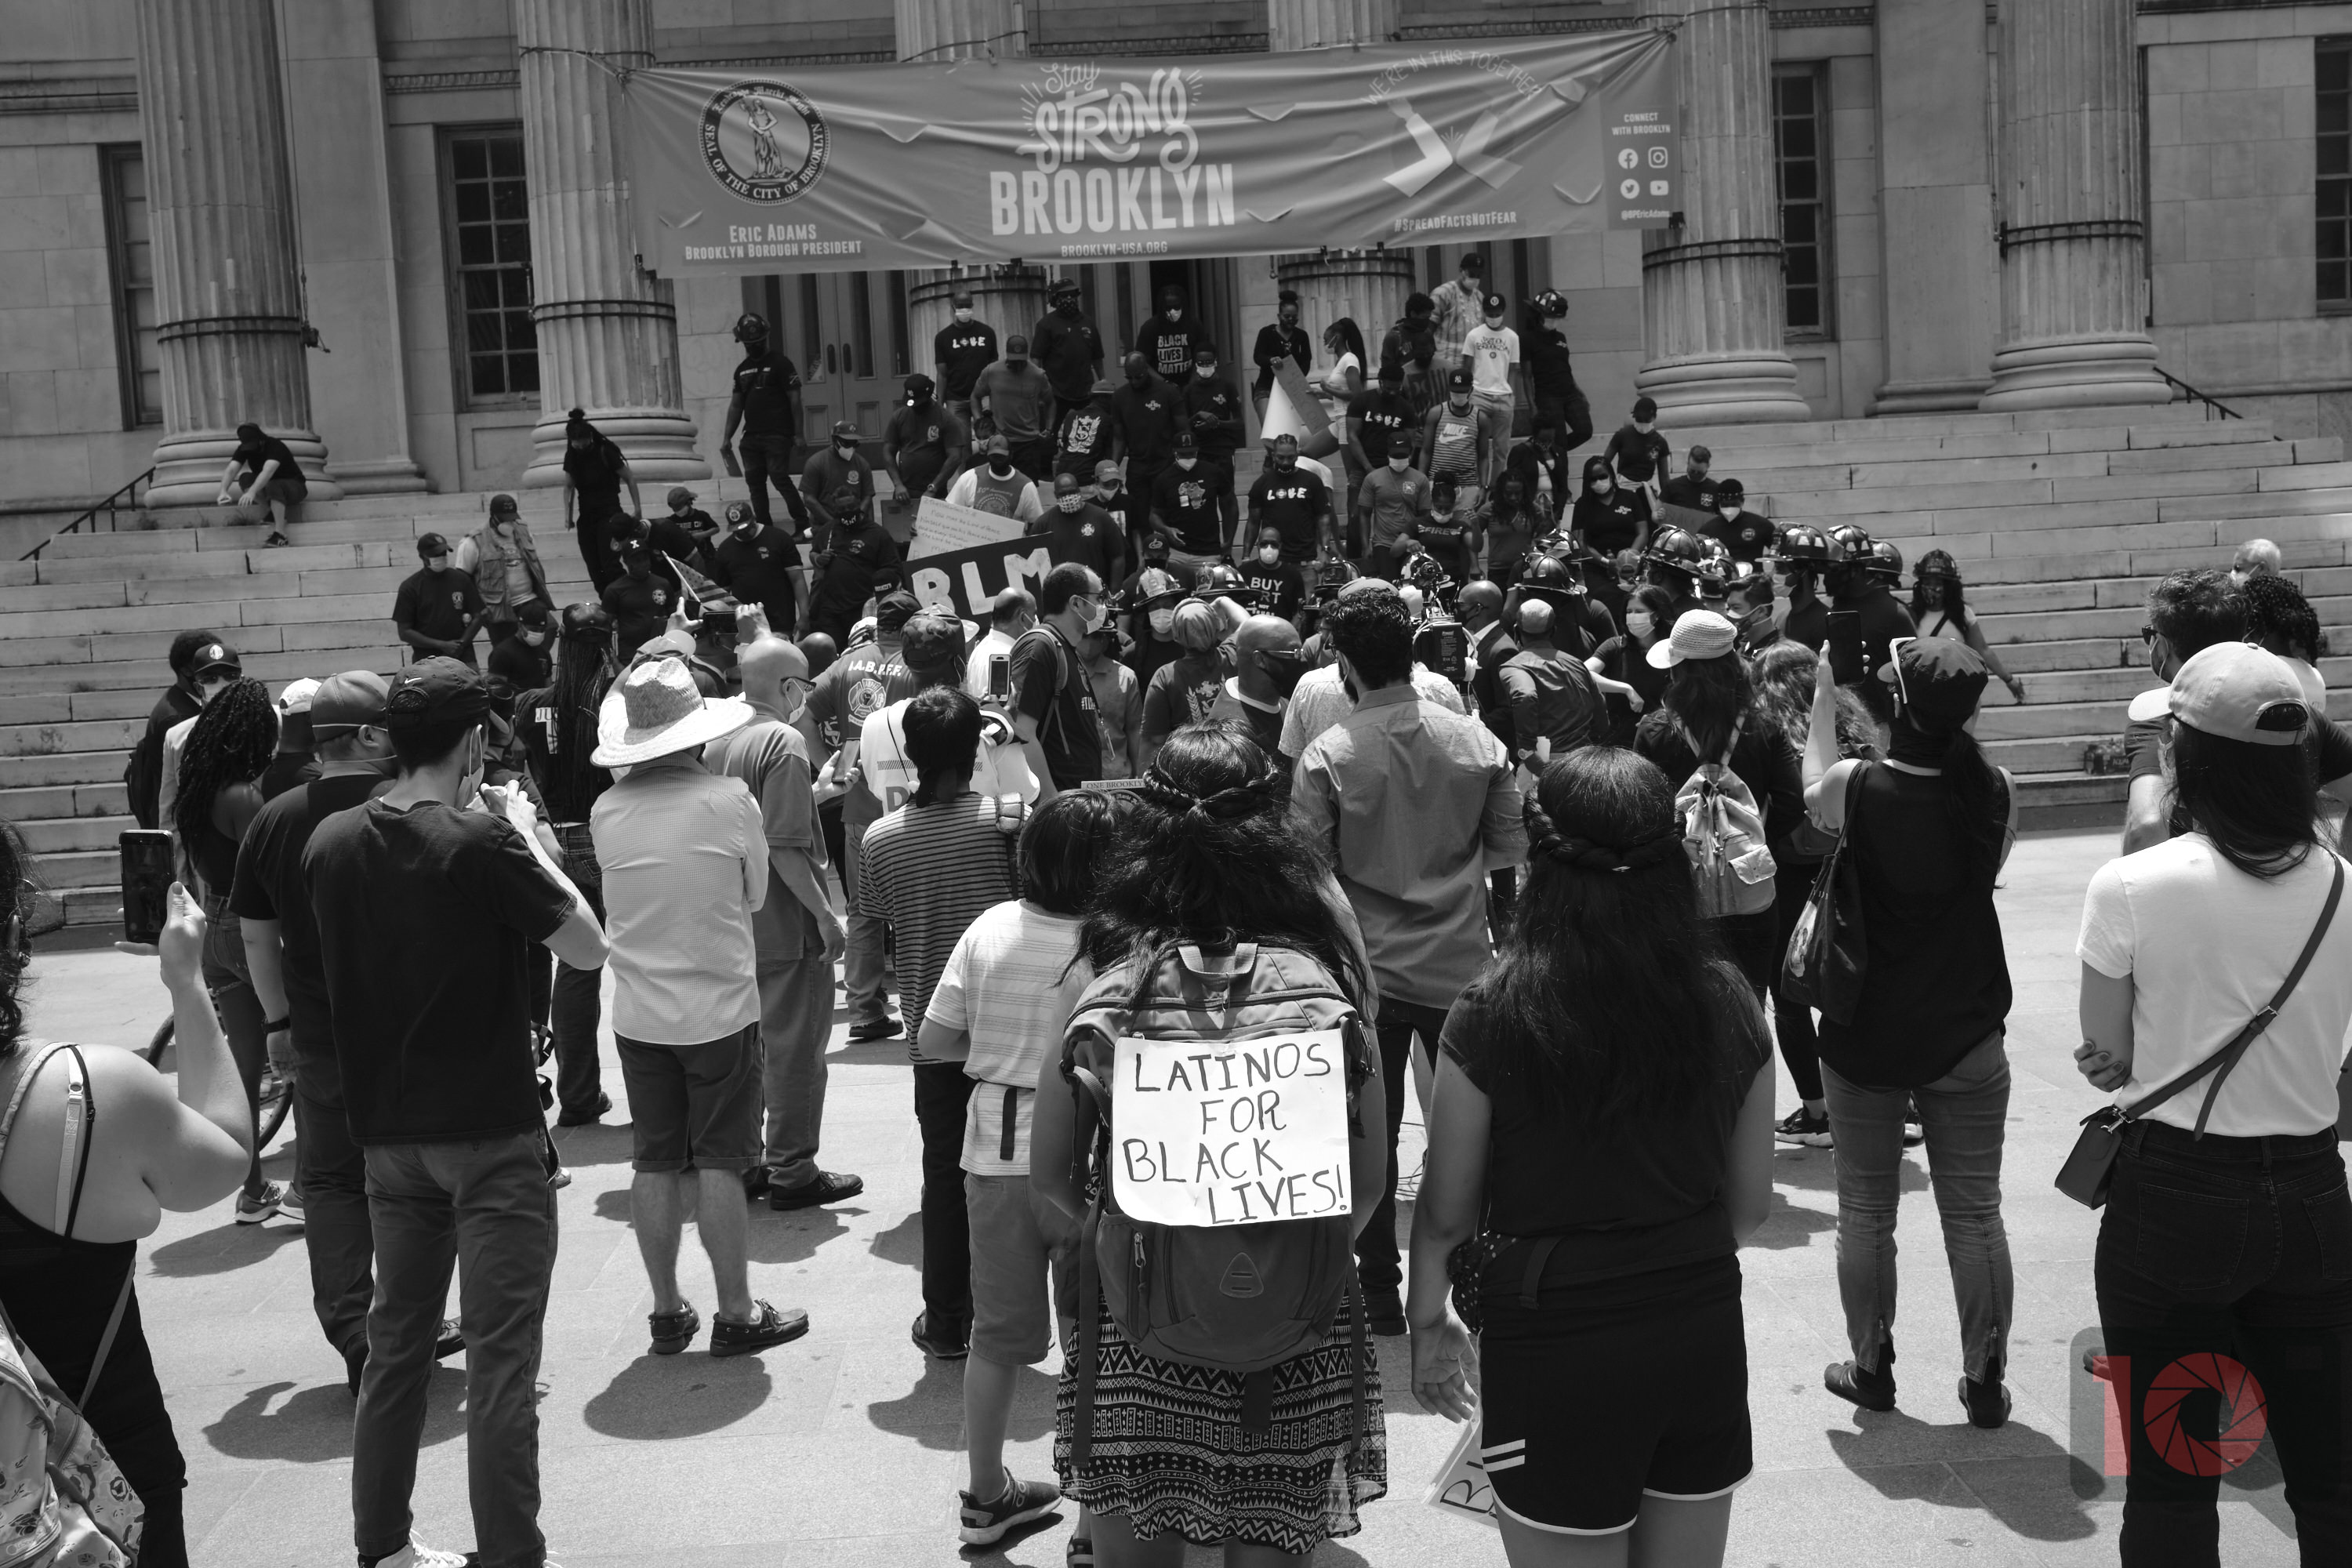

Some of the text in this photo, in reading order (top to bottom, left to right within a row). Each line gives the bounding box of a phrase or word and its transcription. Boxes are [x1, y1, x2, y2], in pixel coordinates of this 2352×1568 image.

[1040, 61, 1100, 93] Stay
[1360, 62, 1409, 105] WE'RE
[1408, 54, 1428, 72] IN
[1428, 49, 1463, 66] THIS
[1015, 67, 1199, 174] STRONG
[1611, 125, 1671, 136] WITH BROOKLYN
[1624, 112, 1659, 123] CONNECT
[705, 122, 824, 199] SEAL OF THE CITY OF BROOKLYN
[990, 163, 1235, 235] BROOKLYN
[684, 240, 862, 260] BROOKLYN BOROUGH PRESIDENT
[729, 223, 818, 244] ERIC ADAMS
[1061, 241, 1168, 257] BROOKLYN-USA.ORG
[1158, 333, 1189, 347] BLACK
[1159, 348, 1181, 362] LIVES
[911, 546, 1053, 615] BLM
[1250, 576, 1284, 592] BUY
[1135, 1044, 1331, 1091] LATINOS
[1200, 1090, 1287, 1135] FOR
[1122, 1138, 1283, 1183] BLACK
[1208, 1164, 1348, 1225] LIVES!
